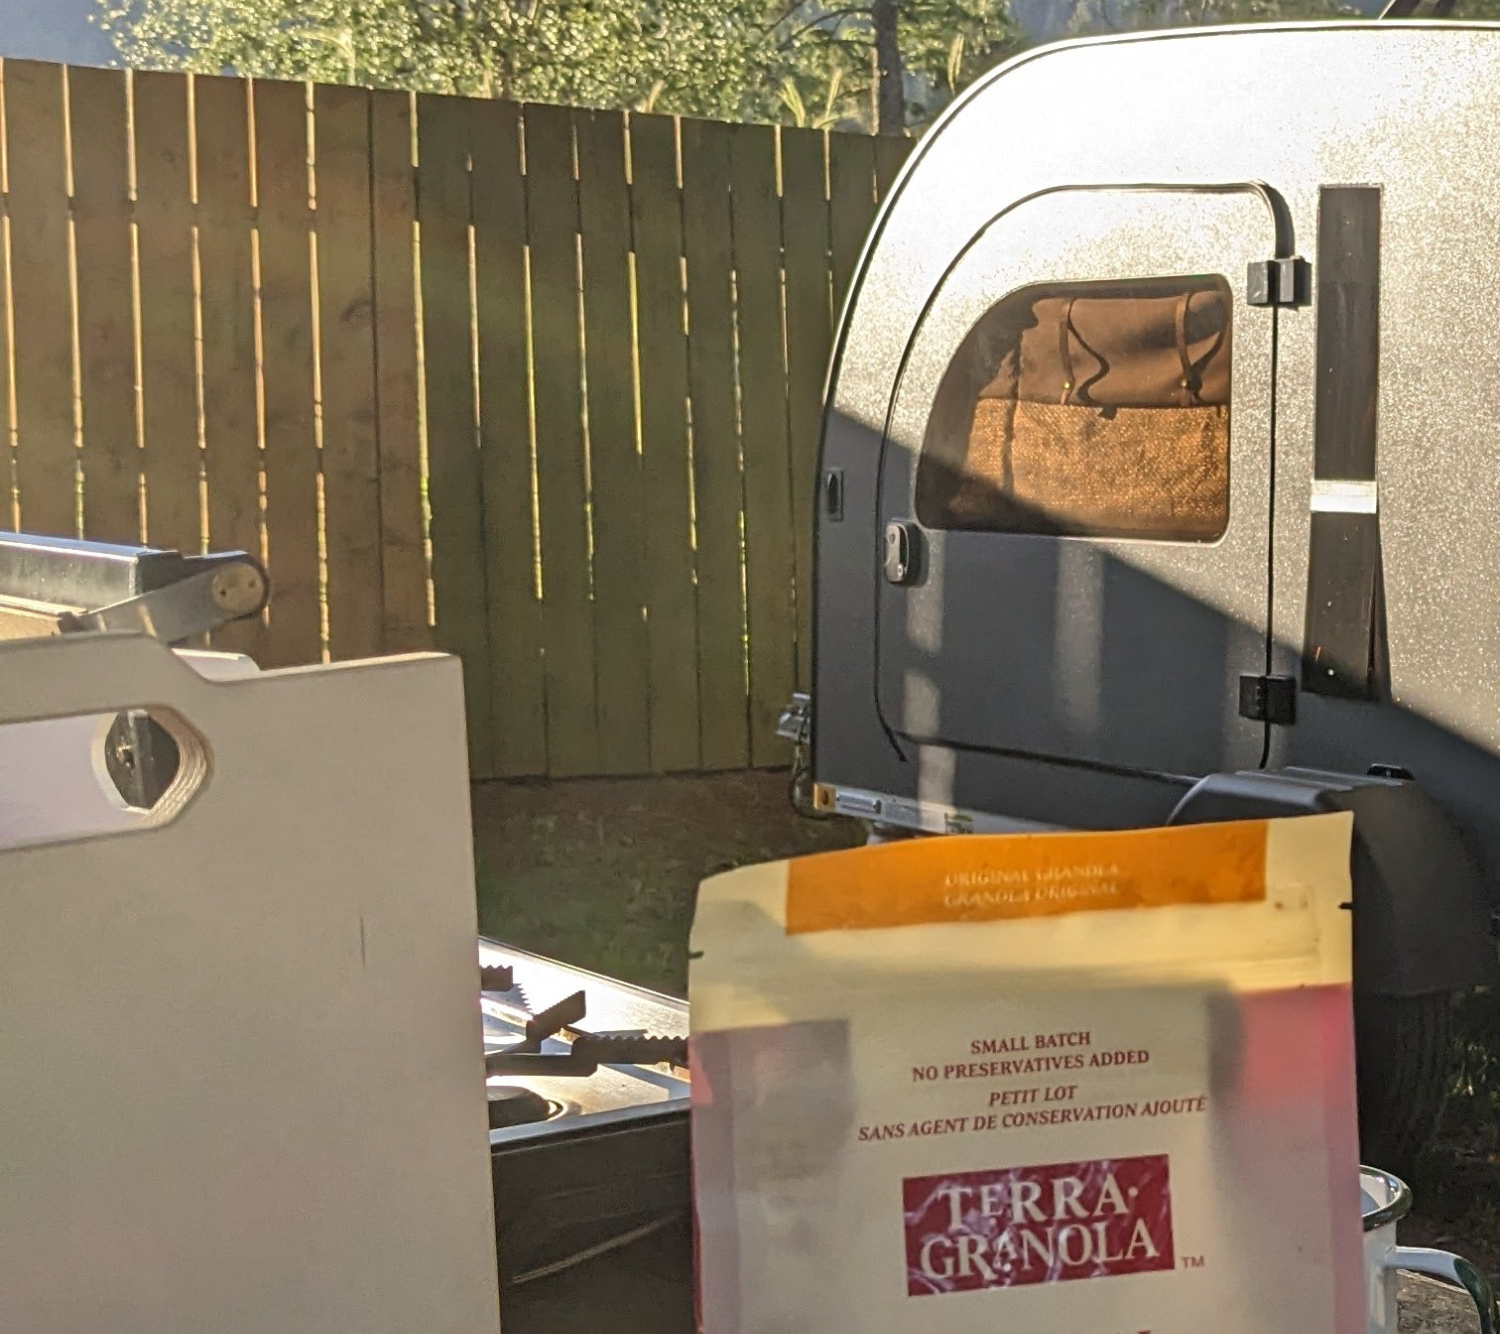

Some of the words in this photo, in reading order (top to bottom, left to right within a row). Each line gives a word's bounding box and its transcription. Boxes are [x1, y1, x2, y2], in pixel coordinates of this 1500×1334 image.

[971, 1037, 1030, 1055] SMALL
[1034, 1031, 1091, 1050] BATCH
[912, 1065, 938, 1083] NO
[944, 1055, 1085, 1080] PRESERVATIVES
[1088, 1049, 1150, 1068] ADDED
[988, 1088, 1040, 1108] PETIT
[1044, 1085, 1078, 1103] LOT
[857, 1123, 906, 1143] SANS
[907, 1116, 970, 1137] AGENT
[972, 1115, 998, 1132] DE
[1001, 1102, 1138, 1129] CONSERVATION
[1140, 1094, 1208, 1117] AJOUTÉ
[936, 1172, 1130, 1233] TERRA
[920, 1217, 1160, 1281] GRANOLA
